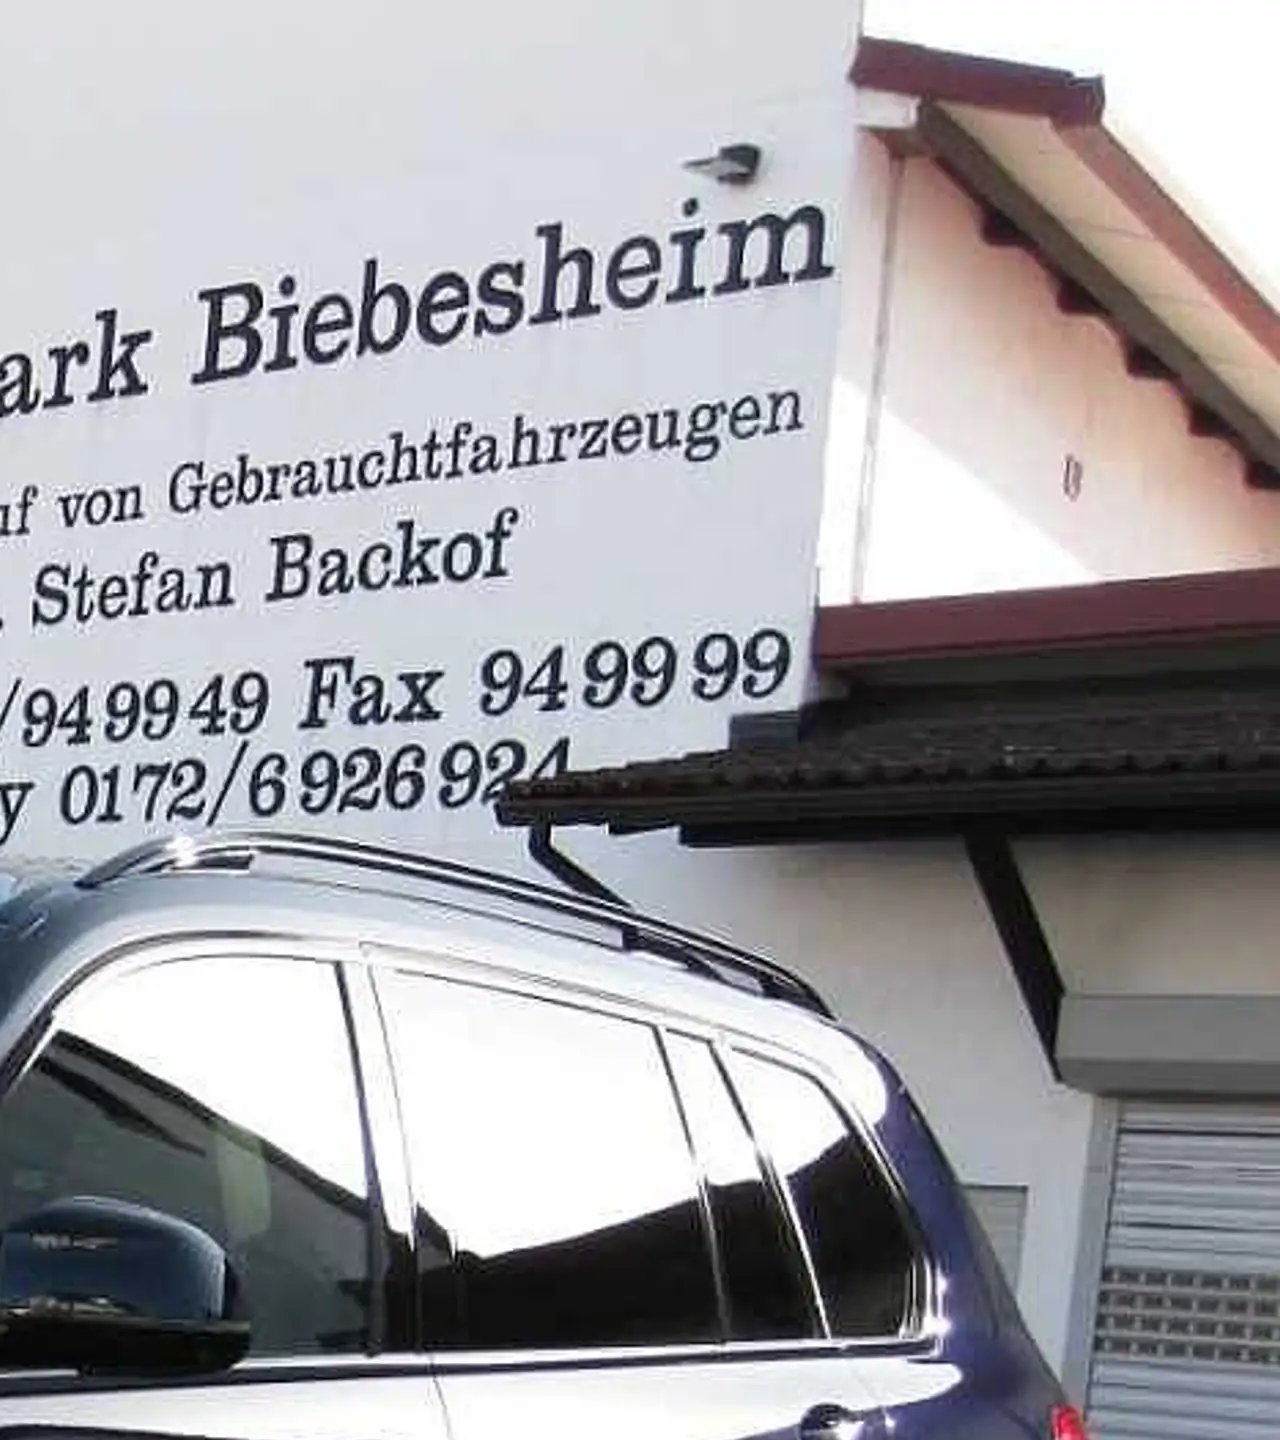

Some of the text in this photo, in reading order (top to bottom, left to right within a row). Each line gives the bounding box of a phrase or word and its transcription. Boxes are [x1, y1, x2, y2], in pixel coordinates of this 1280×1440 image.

[191, 198, 833, 384] Biebesheim
[58, 481, 143, 528] von
[168, 389, 804, 515] Gebrauchtfahrzeugen
[32, 553, 236, 626] Stefan
[266, 508, 517, 601] Backof
[300, 657, 445, 731] Fax
